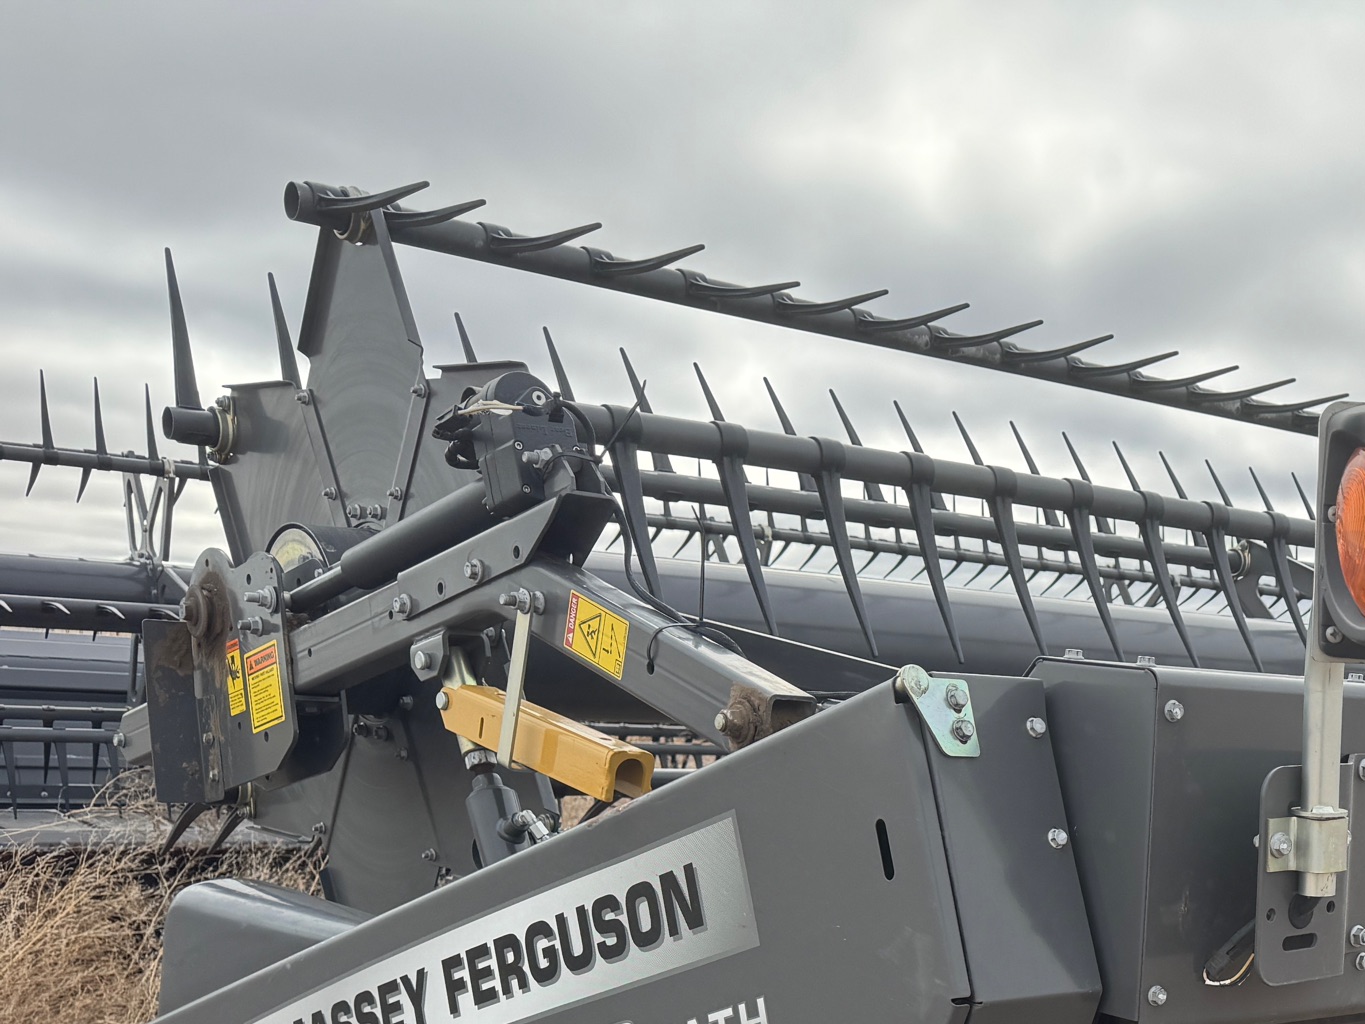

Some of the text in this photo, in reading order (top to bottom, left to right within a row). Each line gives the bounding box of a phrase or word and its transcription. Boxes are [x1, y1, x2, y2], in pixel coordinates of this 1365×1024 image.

[568, 597, 578, 630] DANGER
[254, 651, 274, 666] WARNING
[441, 862, 707, 1018] FERGUSON
